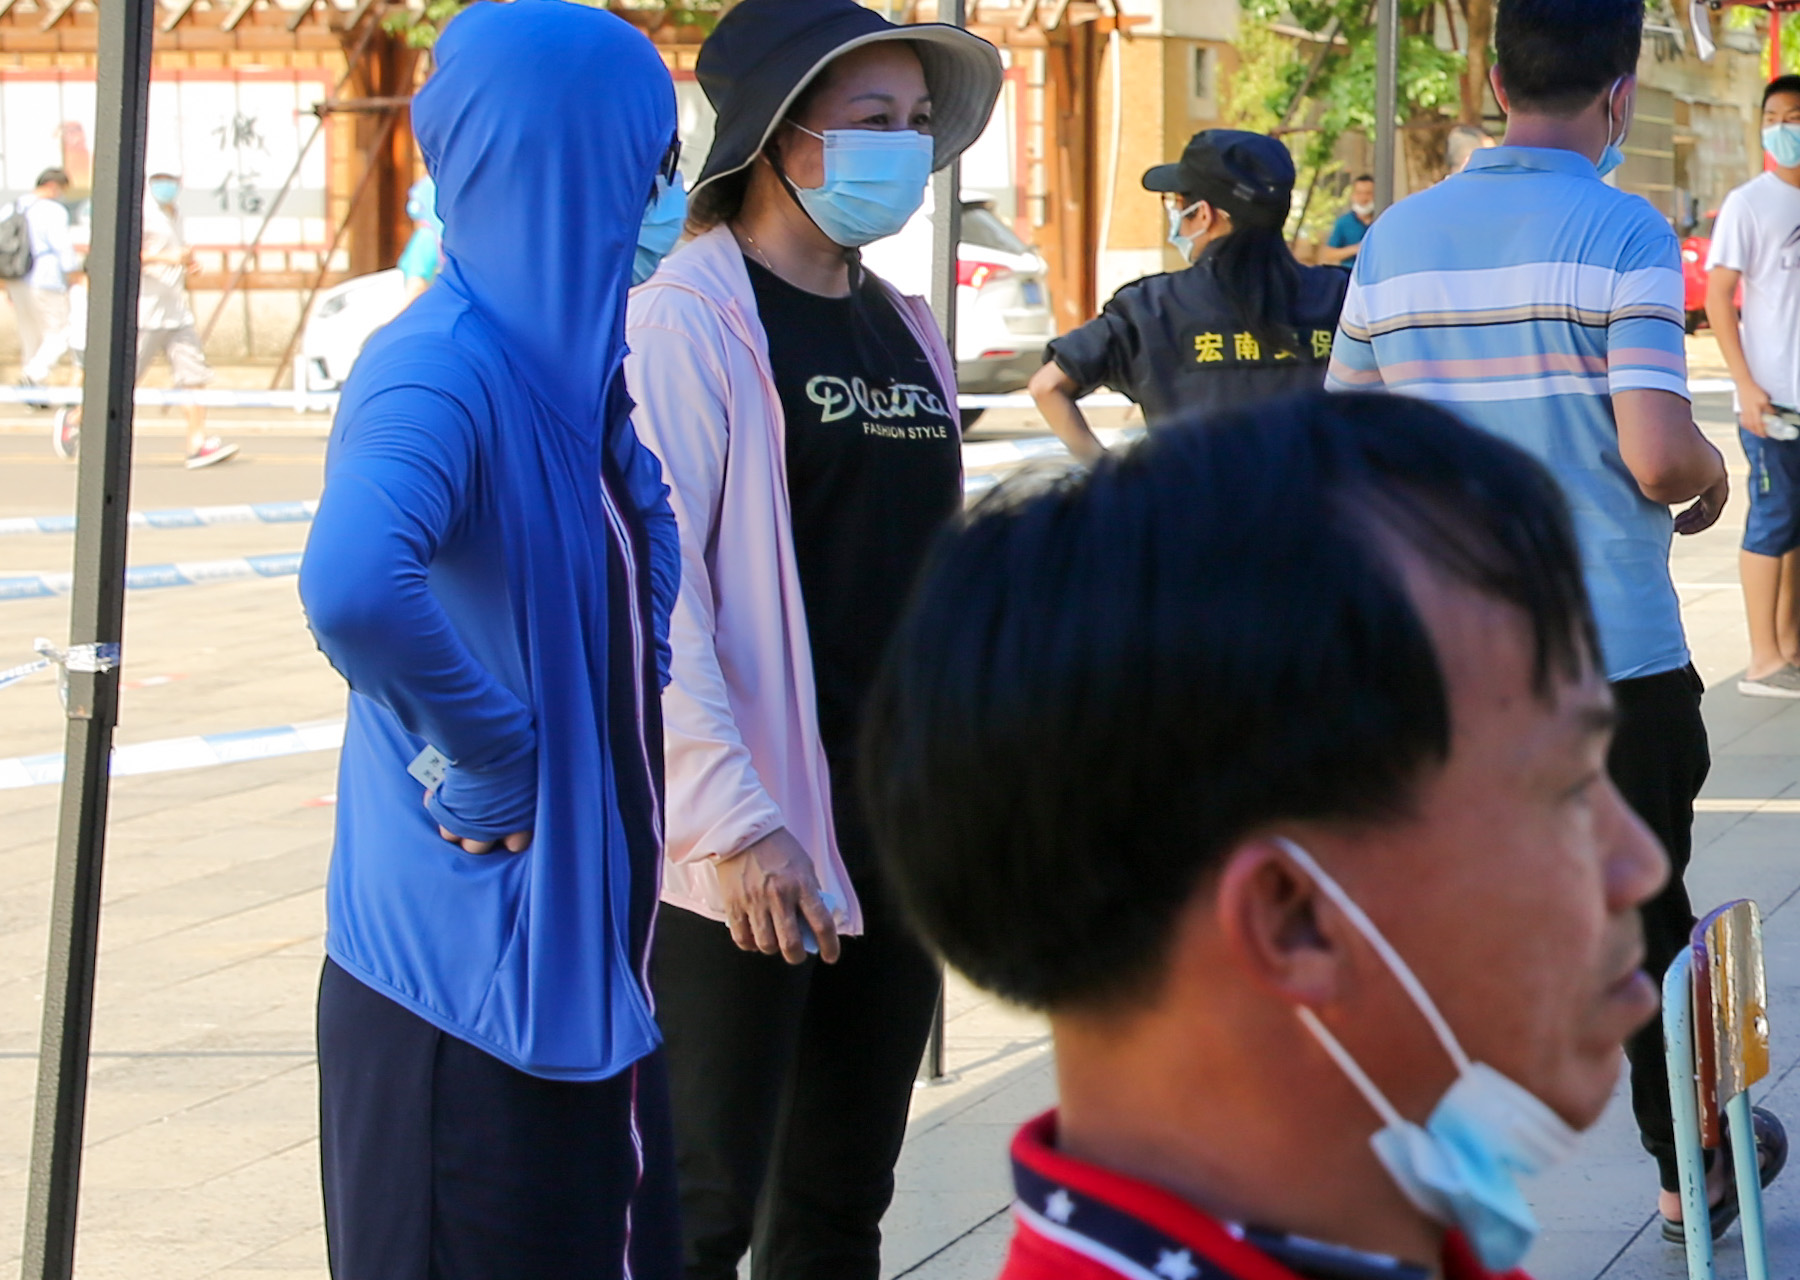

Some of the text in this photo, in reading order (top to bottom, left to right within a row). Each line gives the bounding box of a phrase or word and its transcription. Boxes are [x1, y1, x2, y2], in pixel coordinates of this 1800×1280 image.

[1194, 329, 1333, 363] 宏南保
[862, 422, 948, 439] FASHION STYLE
